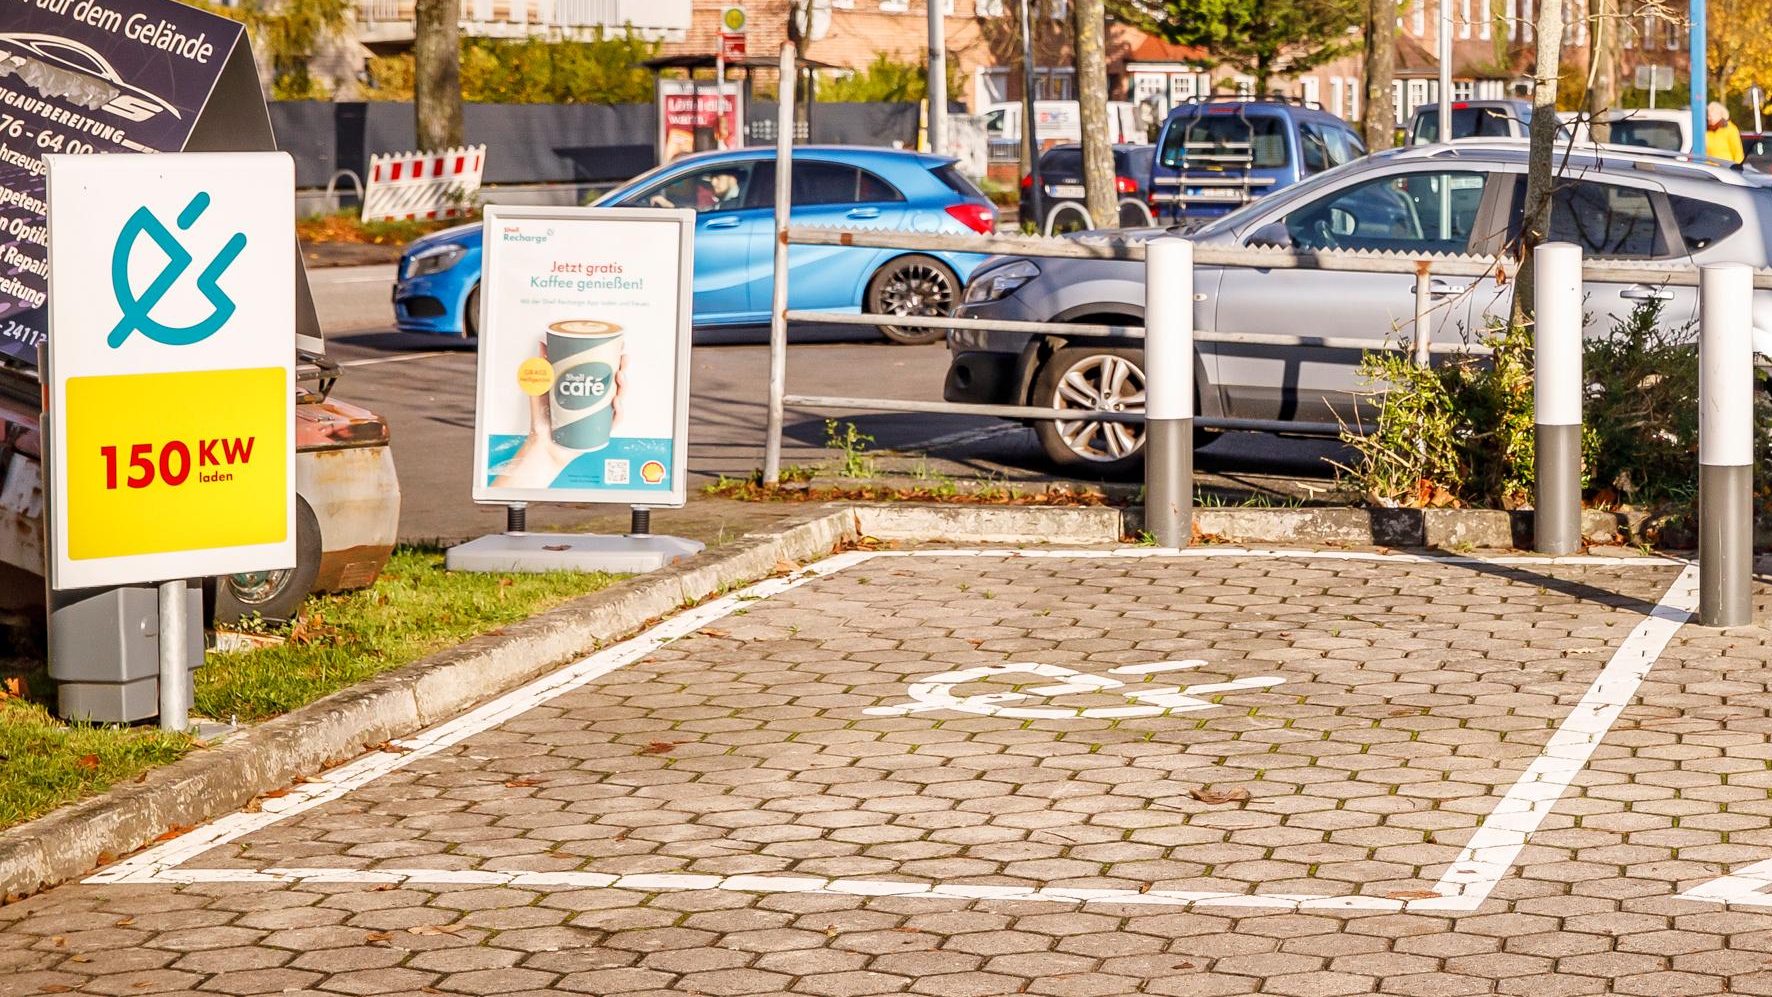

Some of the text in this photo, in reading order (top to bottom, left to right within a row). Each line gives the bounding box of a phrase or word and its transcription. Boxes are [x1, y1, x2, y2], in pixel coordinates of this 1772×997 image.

[124, 13, 214, 64] Gelände
[37, 130, 65, 152] 64
[503, 233, 547, 244] Recharge
[550, 261, 623, 276] Jetzt gratis
[530, 275, 643, 292] Kaffee genießen!
[559, 375, 605, 396] café
[100, 436, 255, 490] 150 KW
[199, 471, 233, 483] laden
